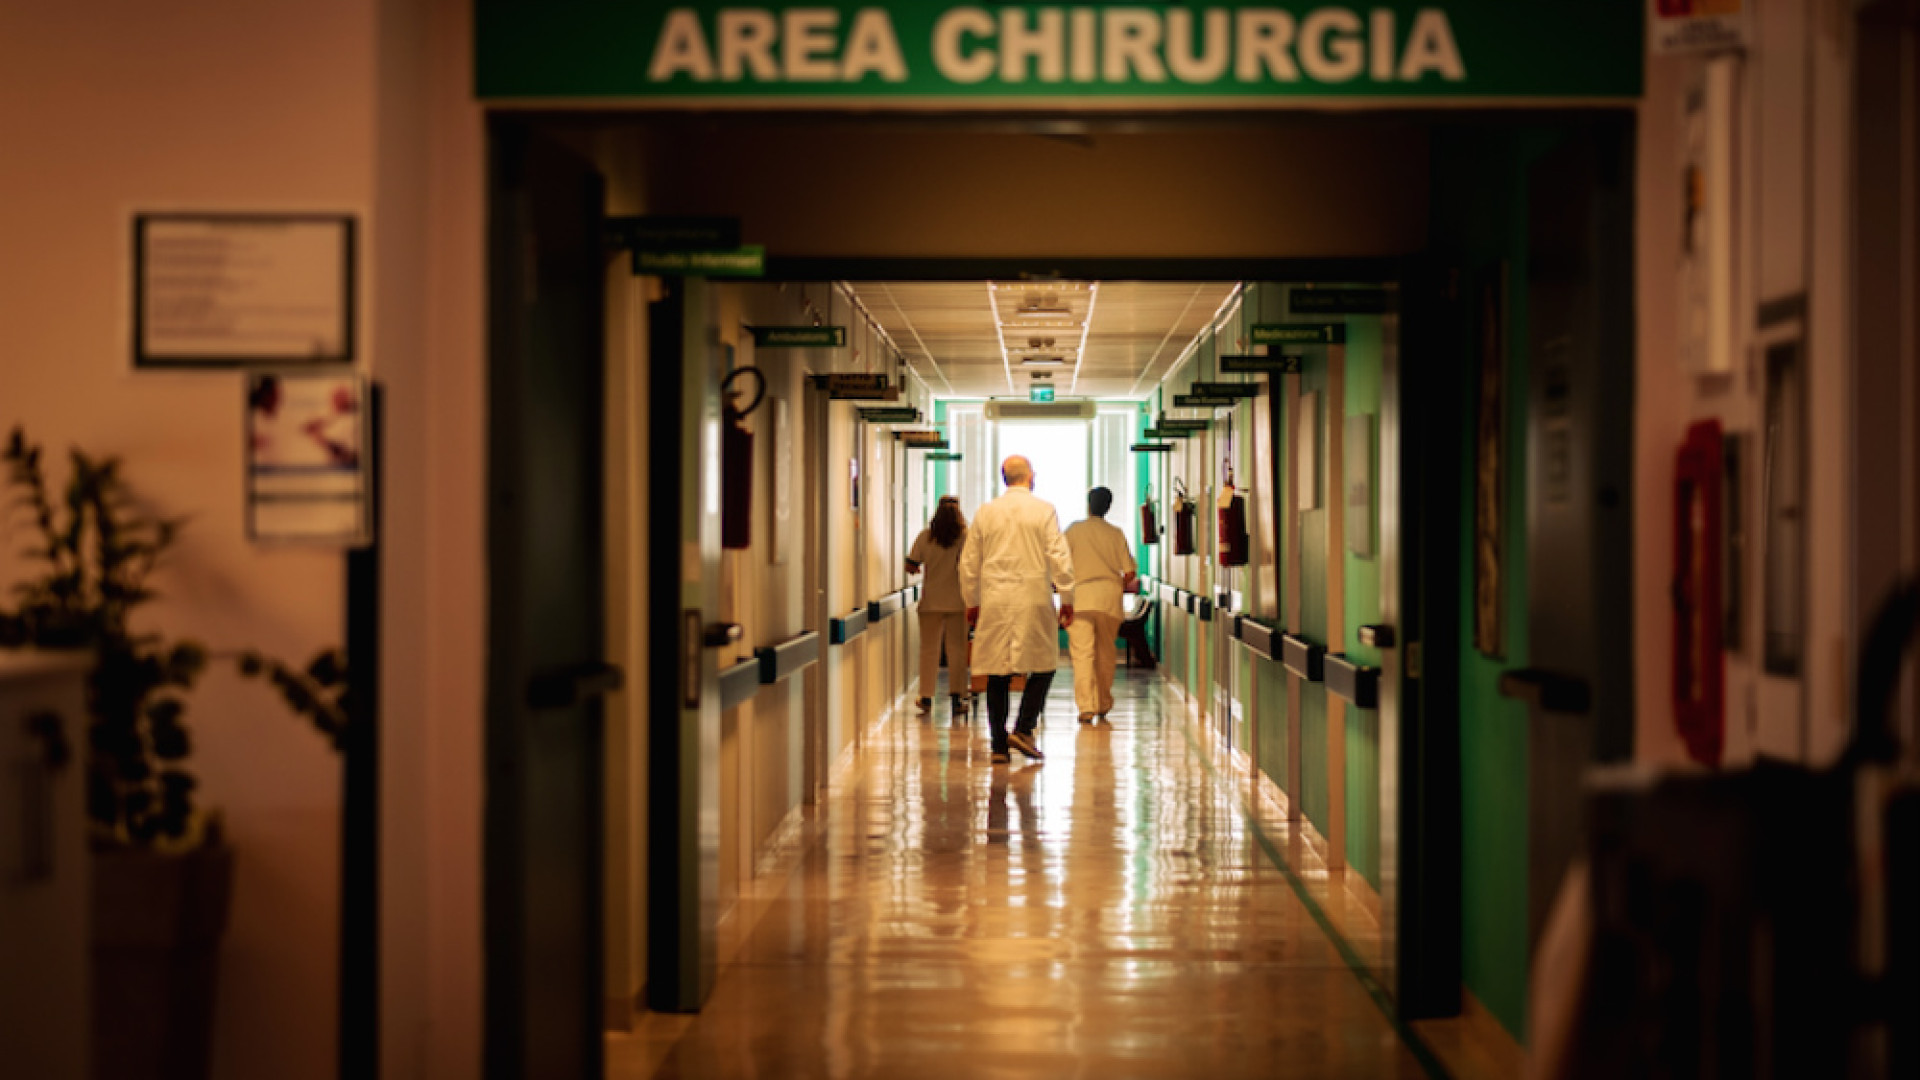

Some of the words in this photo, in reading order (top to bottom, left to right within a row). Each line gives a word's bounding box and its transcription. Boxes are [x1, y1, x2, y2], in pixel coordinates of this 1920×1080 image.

[647, 8, 908, 82] AREA
[931, 7, 1465, 83] CHIRURGIA
[834, 328, 843, 344] 1
[1322, 325, 1333, 341] 1
[1286, 357, 1297, 371] 2
